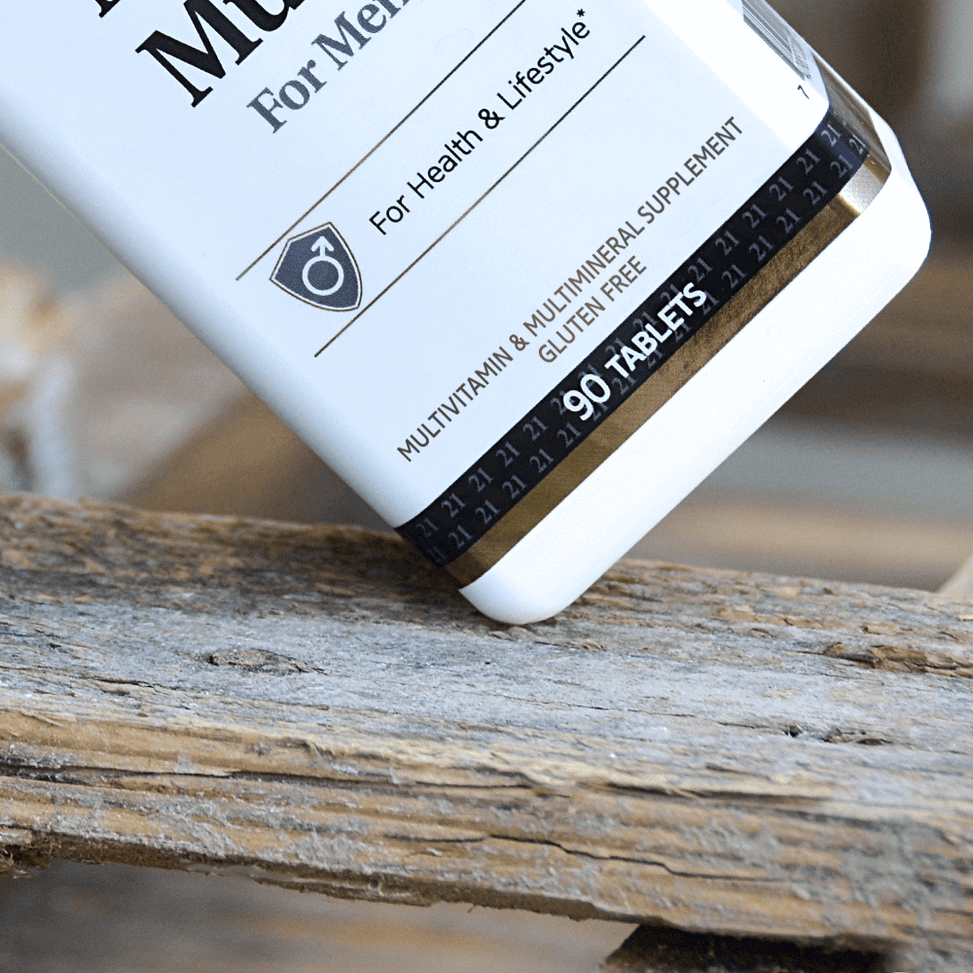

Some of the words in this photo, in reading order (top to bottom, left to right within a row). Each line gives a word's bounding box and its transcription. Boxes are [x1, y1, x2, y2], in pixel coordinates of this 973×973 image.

[246, 60, 327, 134] For
[798, 85, 809, 98] 7
[369, 195, 410, 235] For
[407, 130, 483, 199] Health
[478, 109, 505, 129] &
[397, 347, 512, 462] MULTIVITAMIN
[509, 334, 530, 351] &
[523, 221, 642, 337] MULTIMINERAL
[637, 116, 742, 224] SUPPLEMENT
[442, 493, 467, 517] 21
[469, 468, 494, 492] 21
[496, 441, 521, 467] 21
[523, 416, 548, 441] 21
[687, 257, 713, 282] 21
[715, 230, 740, 256] 21
[742, 204, 768, 228] 21
[769, 177, 794, 201] 21
[796, 149, 821, 174] 21
[821, 124, 841, 146] 21
[448, 525, 473, 548] 21
[476, 500, 501, 524] 21
[503, 475, 528, 499] 21
[529, 448, 554, 473] 21
[557, 422, 582, 448] 21
[722, 264, 746, 289] 21
[749, 235, 774, 262] 21
[776, 208, 802, 234] 21
[803, 181, 828, 205] 21
[830, 155, 854, 178] 21
[539, 296, 605, 363] GLUTEN
[600, 255, 647, 302] FREE
[564, 375, 610, 420] 90
[605, 283, 706, 377] TABLETS
